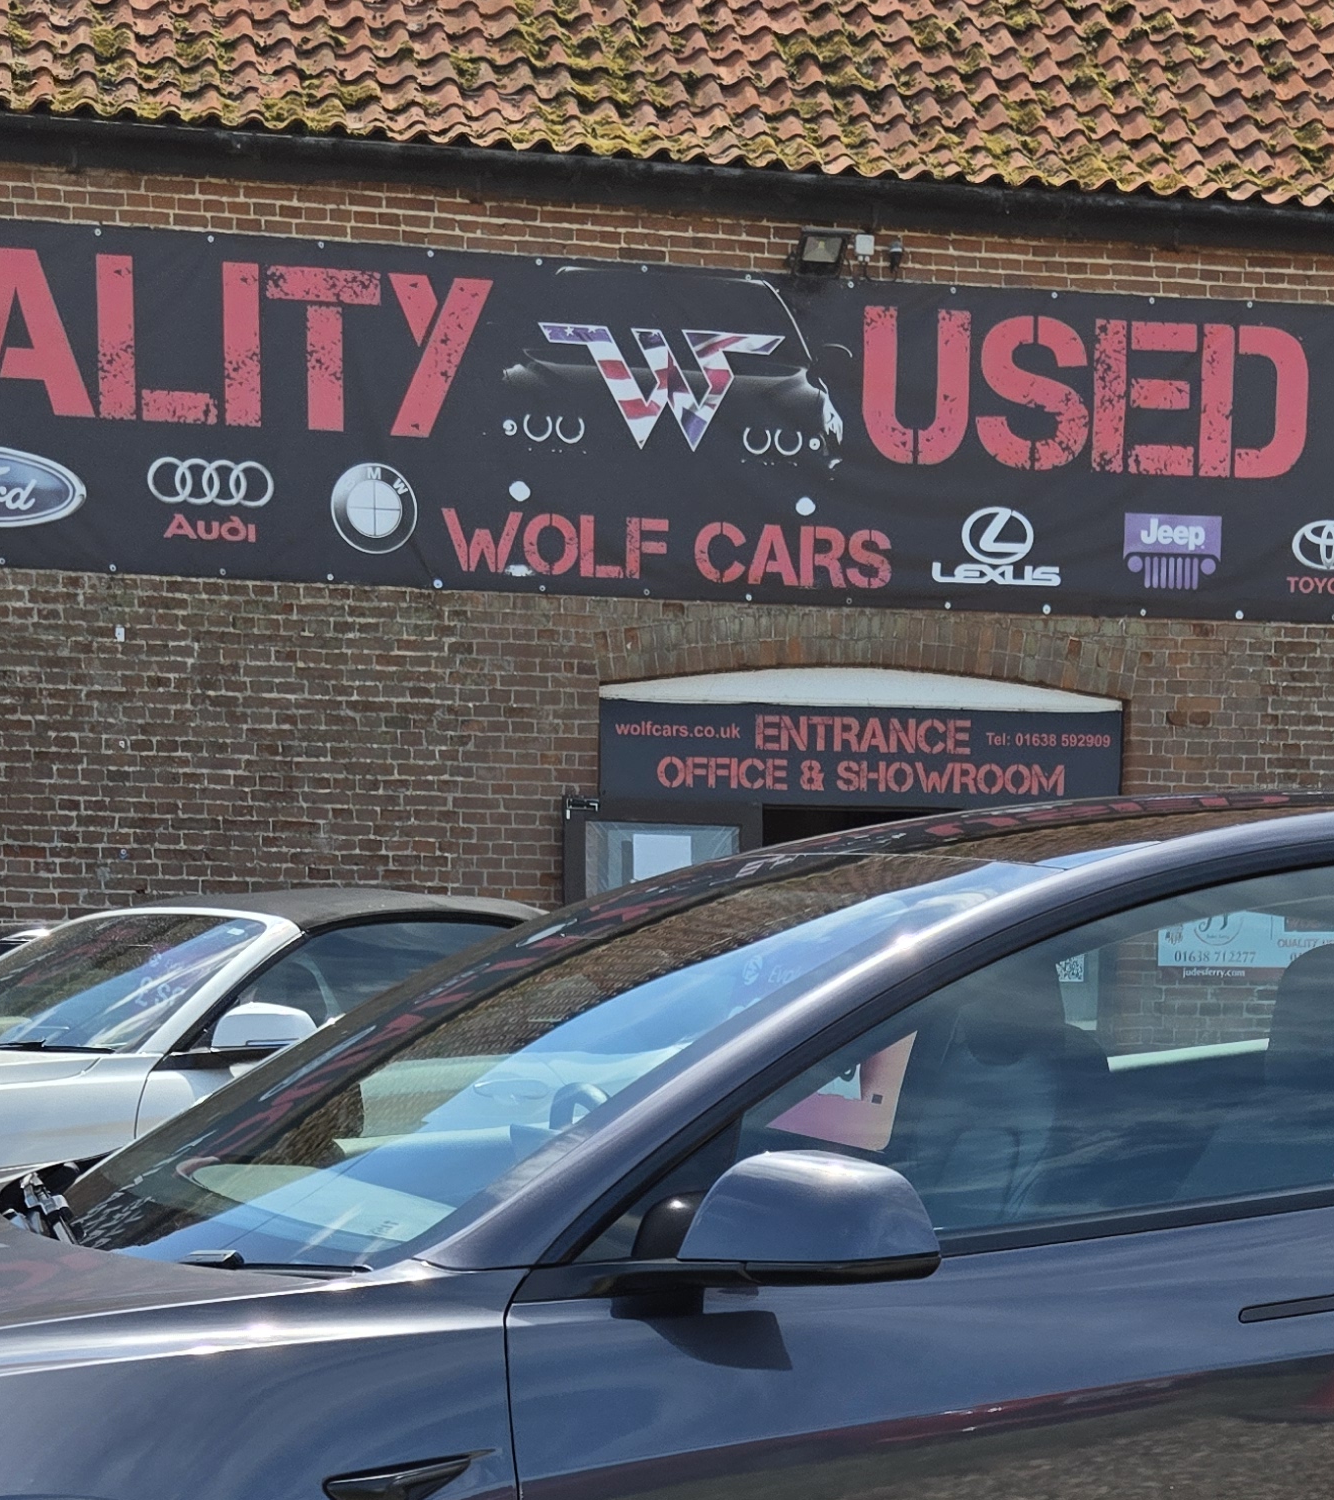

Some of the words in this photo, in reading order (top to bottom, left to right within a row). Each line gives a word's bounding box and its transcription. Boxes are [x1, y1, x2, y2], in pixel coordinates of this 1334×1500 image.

[862, 305, 1309, 479] USED
[163, 513, 257, 543] Audi
[1140, 518, 1205, 550] Jeep
[441, 507, 669, 579] WOLF
[694, 521, 892, 588] CARS
[932, 562, 1061, 586] LEXUS
[615, 721, 740, 739] wolfcars.co.uk
[755, 714, 971, 755] ENTRANCE
[986, 732, 1011, 746] Tel:
[1015, 733, 1057, 747] 01638
[1061, 734, 1111, 748] 592909
[657, 756, 788, 790] OFFICE
[800, 759, 824, 791] &
[836, 760, 1065, 796] SHOWROOM
[1174, 951, 1210, 963] 01638
